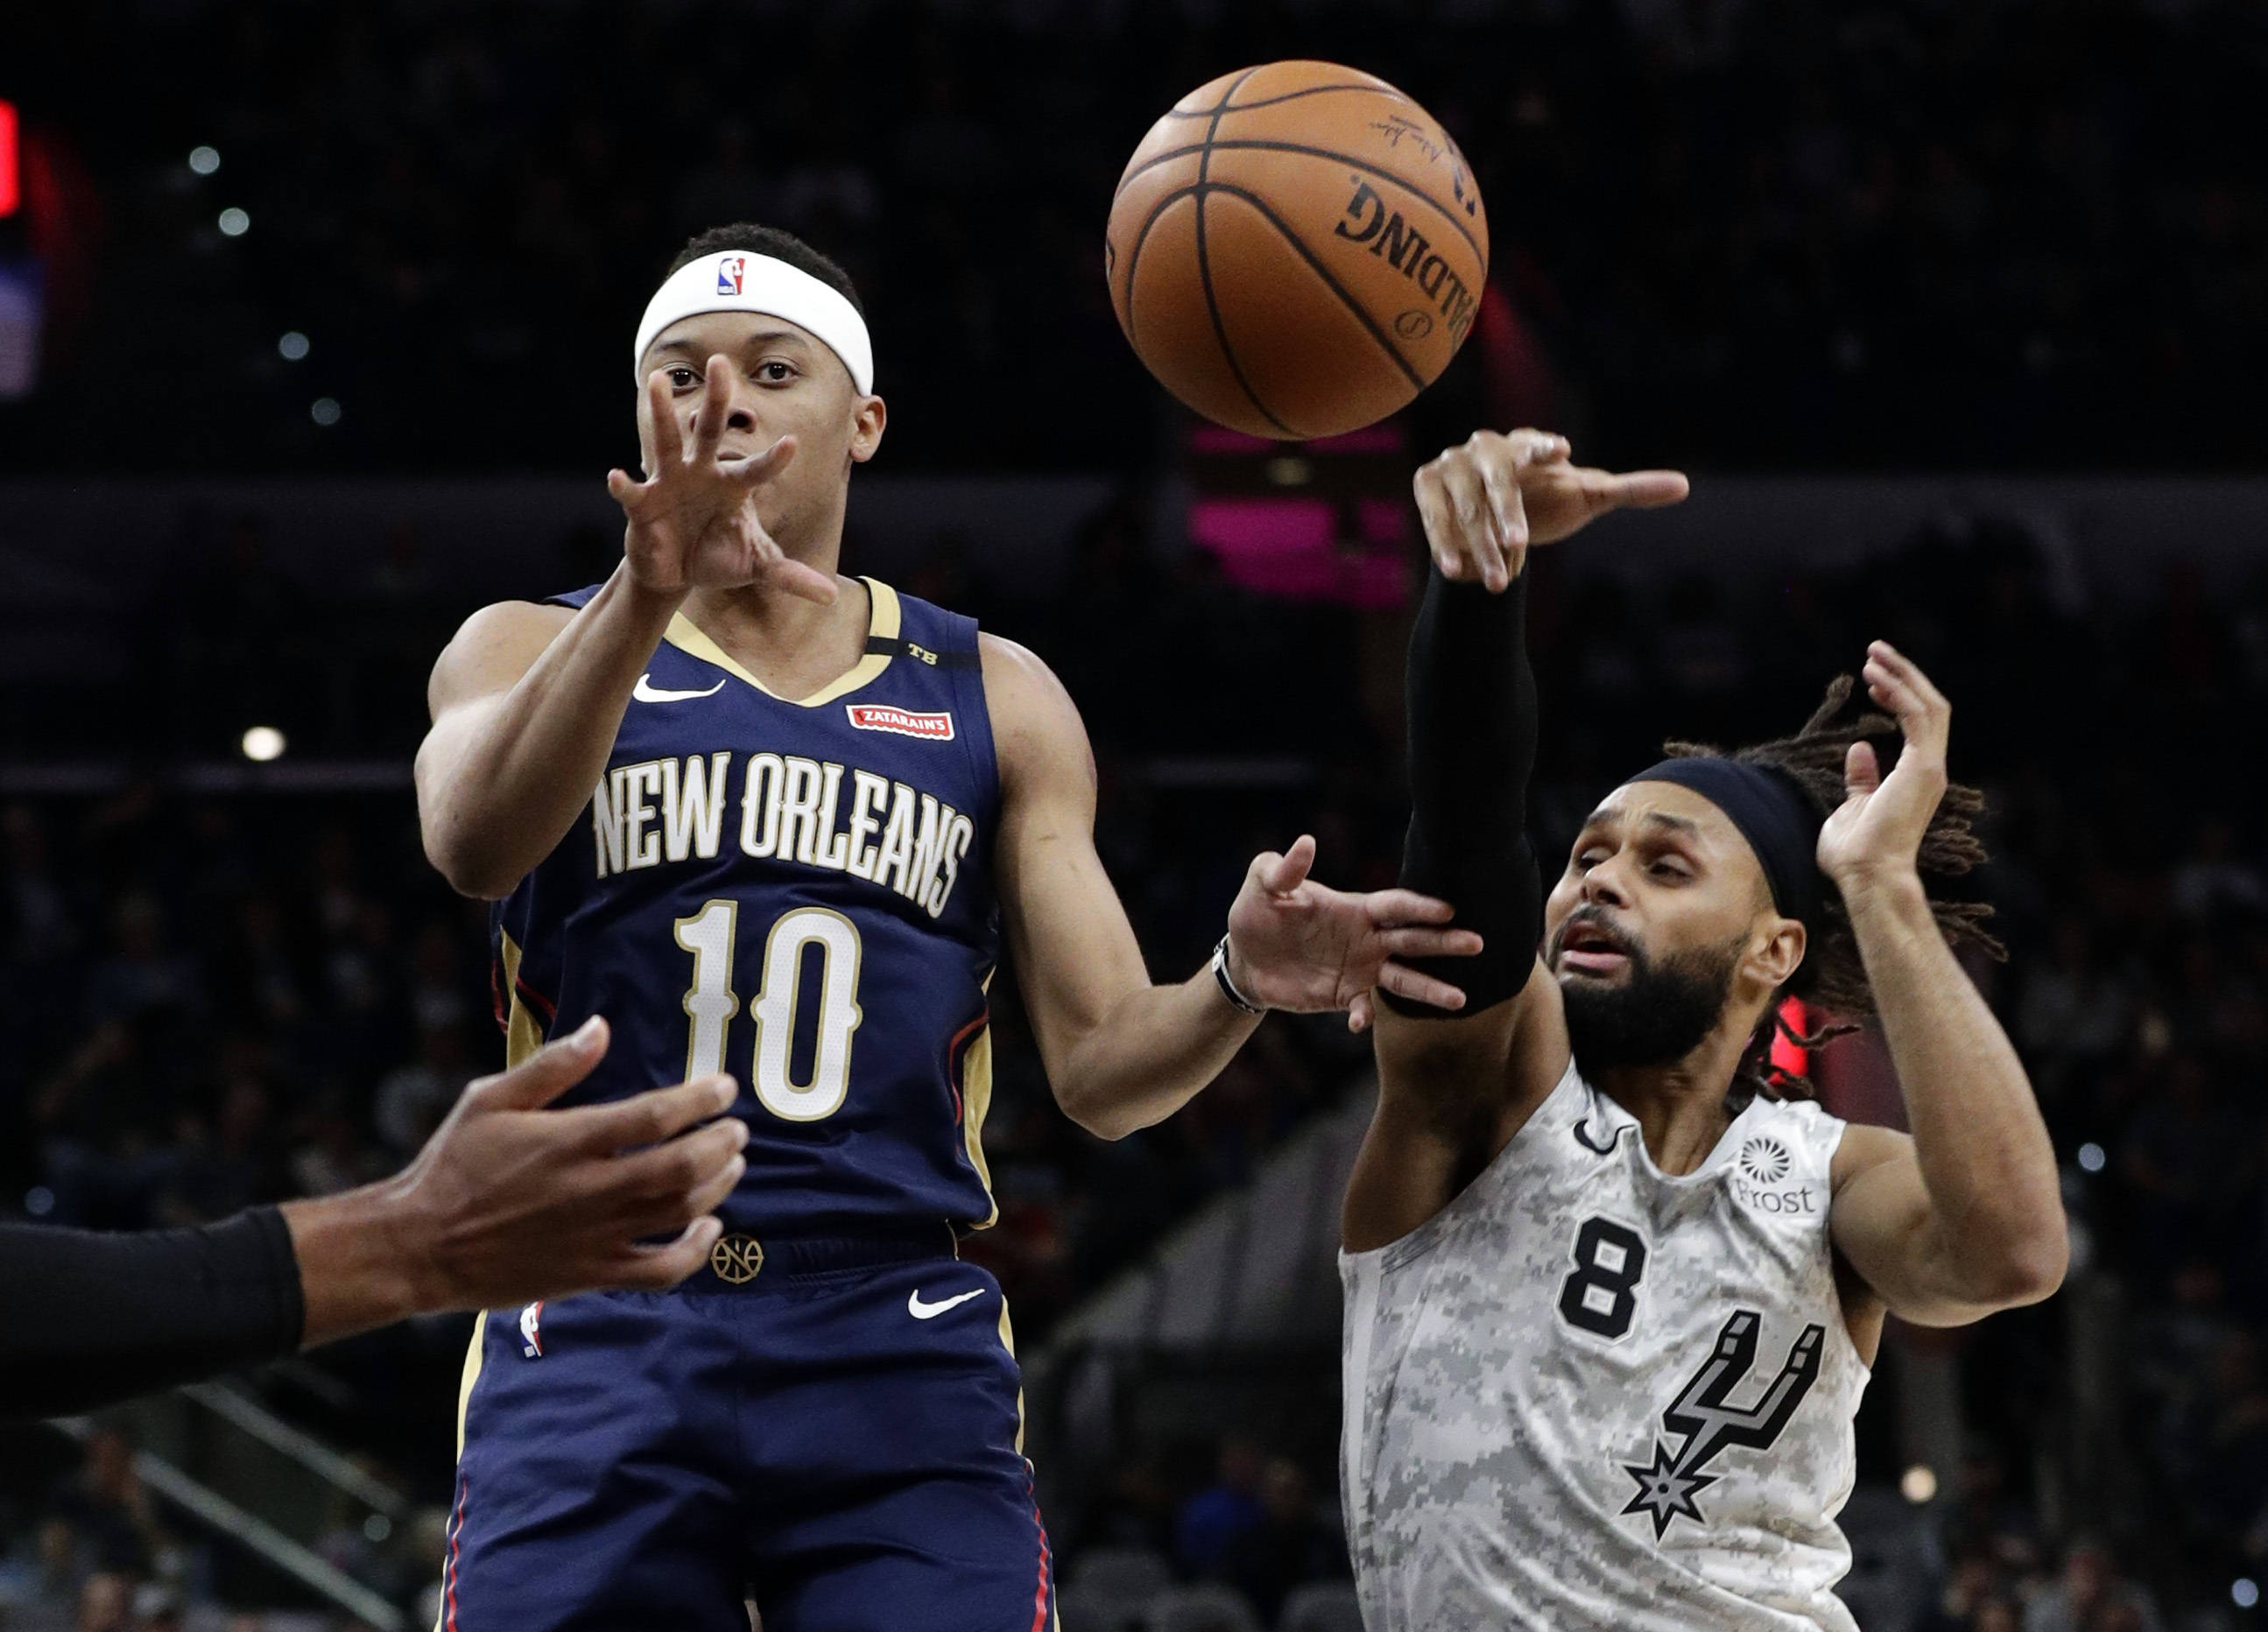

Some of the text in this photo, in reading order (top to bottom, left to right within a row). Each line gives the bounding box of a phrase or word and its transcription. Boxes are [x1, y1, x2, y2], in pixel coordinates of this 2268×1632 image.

[908, 643, 938, 665] TB
[593, 751, 974, 919] NEW ORLEANS
[673, 898, 863, 1122] 10
[1557, 1214, 1648, 1341] 8
